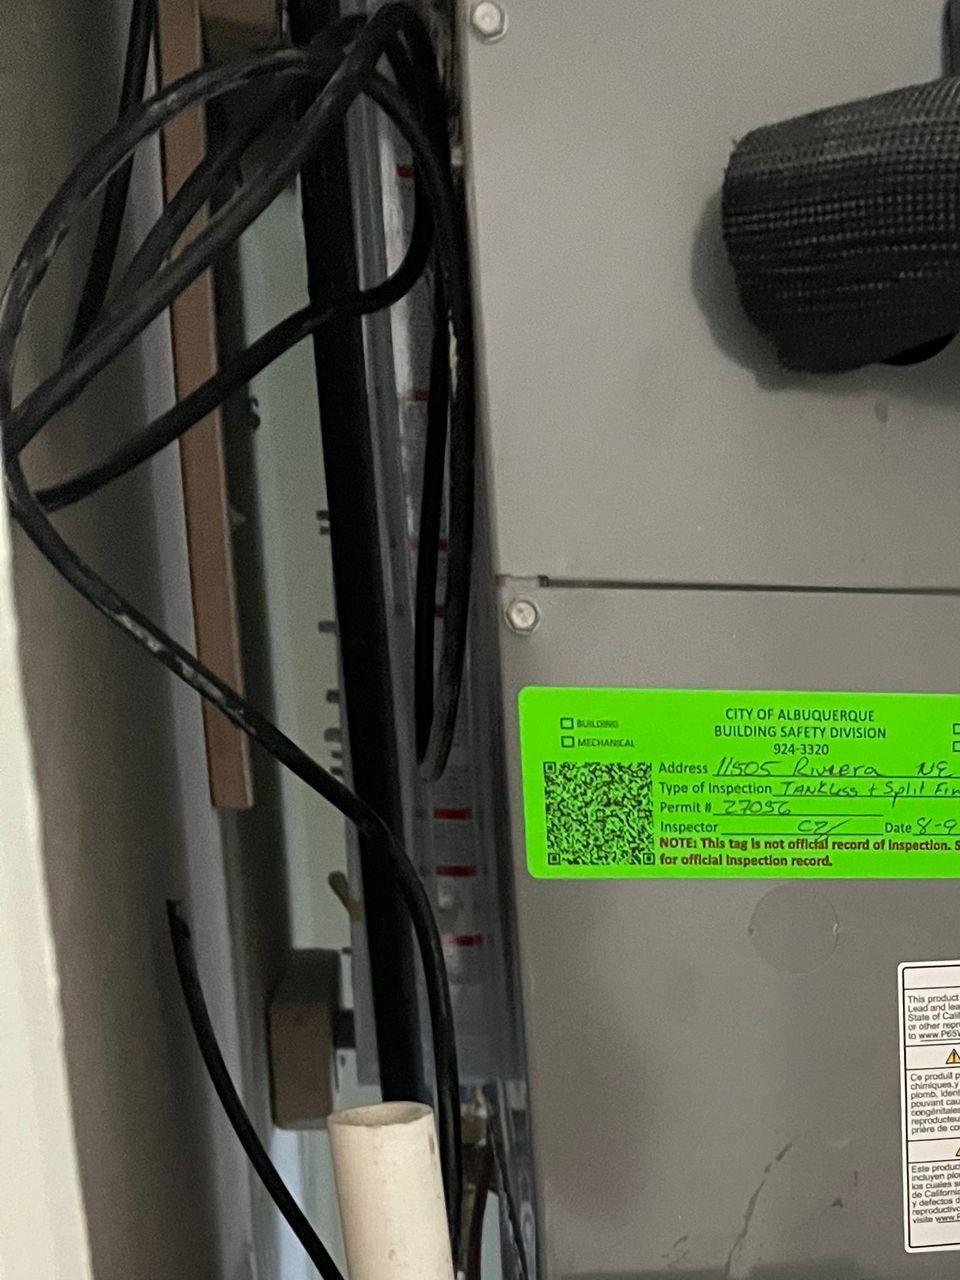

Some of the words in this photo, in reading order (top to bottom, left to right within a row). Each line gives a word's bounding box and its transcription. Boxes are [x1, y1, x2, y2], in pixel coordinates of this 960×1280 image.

[726, 708, 754, 721] CITY
[757, 708, 774, 721] OF
[778, 708, 875, 723] ALBUQUERQUE
[576, 719, 619, 729] BUILDING
[714, 725, 777, 738] BUILDING
[780, 725, 827, 739] SAFETY
[830, 726, 887, 739] DIVISION
[577, 738, 635, 748] MECHANICAL
[773, 743, 829, 756] 924-3320
[658, 762, 708, 774] Address
[659, 782, 689, 796] Type
[692, 781, 705, 794] of
[708, 782, 773, 797] Inspection
[660, 801, 701, 813] Permit
[704, 802, 712, 813] #
[660, 821, 718, 835] Inspector
[885, 822, 912, 834] Date
[659, 838, 697, 849] NOTE:
[701, 838, 725, 849] This
[729, 839, 748, 851] tag
[751, 838, 761, 849] is
[764, 839, 785, 849] not
[788, 838, 828, 850] official
[832, 838, 870, 850] record
[873, 838, 886, 850] of
[659, 853, 678, 865] for
[681, 853, 722, 865] official
[791, 854, 833, 866] record.
[927, 994, 959, 1004] product
[907, 1004, 928, 1012] Lead
[930, 1003, 946, 1011] and
